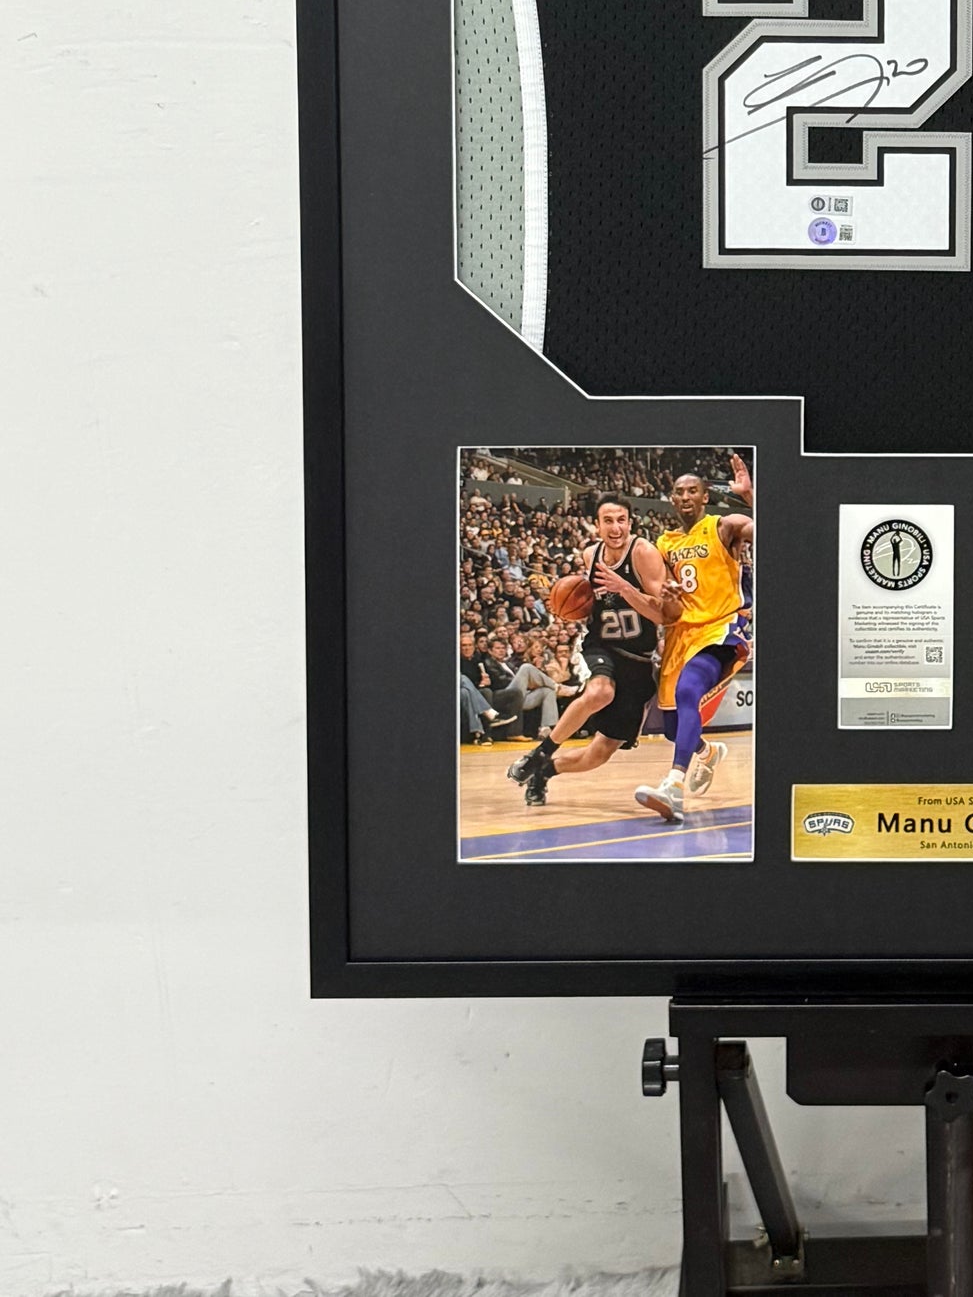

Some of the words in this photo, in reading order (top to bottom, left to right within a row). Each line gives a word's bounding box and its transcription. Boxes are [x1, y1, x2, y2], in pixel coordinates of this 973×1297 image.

[867, 524, 890, 544] MANU
[892, 522, 927, 543] GINOBILI
[680, 564, 698, 593] 8
[897, 567, 926, 588] SPORTS
[601, 609, 642, 639] 20
[917, 796, 942, 805] From
[945, 796, 965, 805] USA
[808, 817, 850, 830] SPURS
[877, 812, 952, 834] Manu
[920, 840, 938, 849] San
